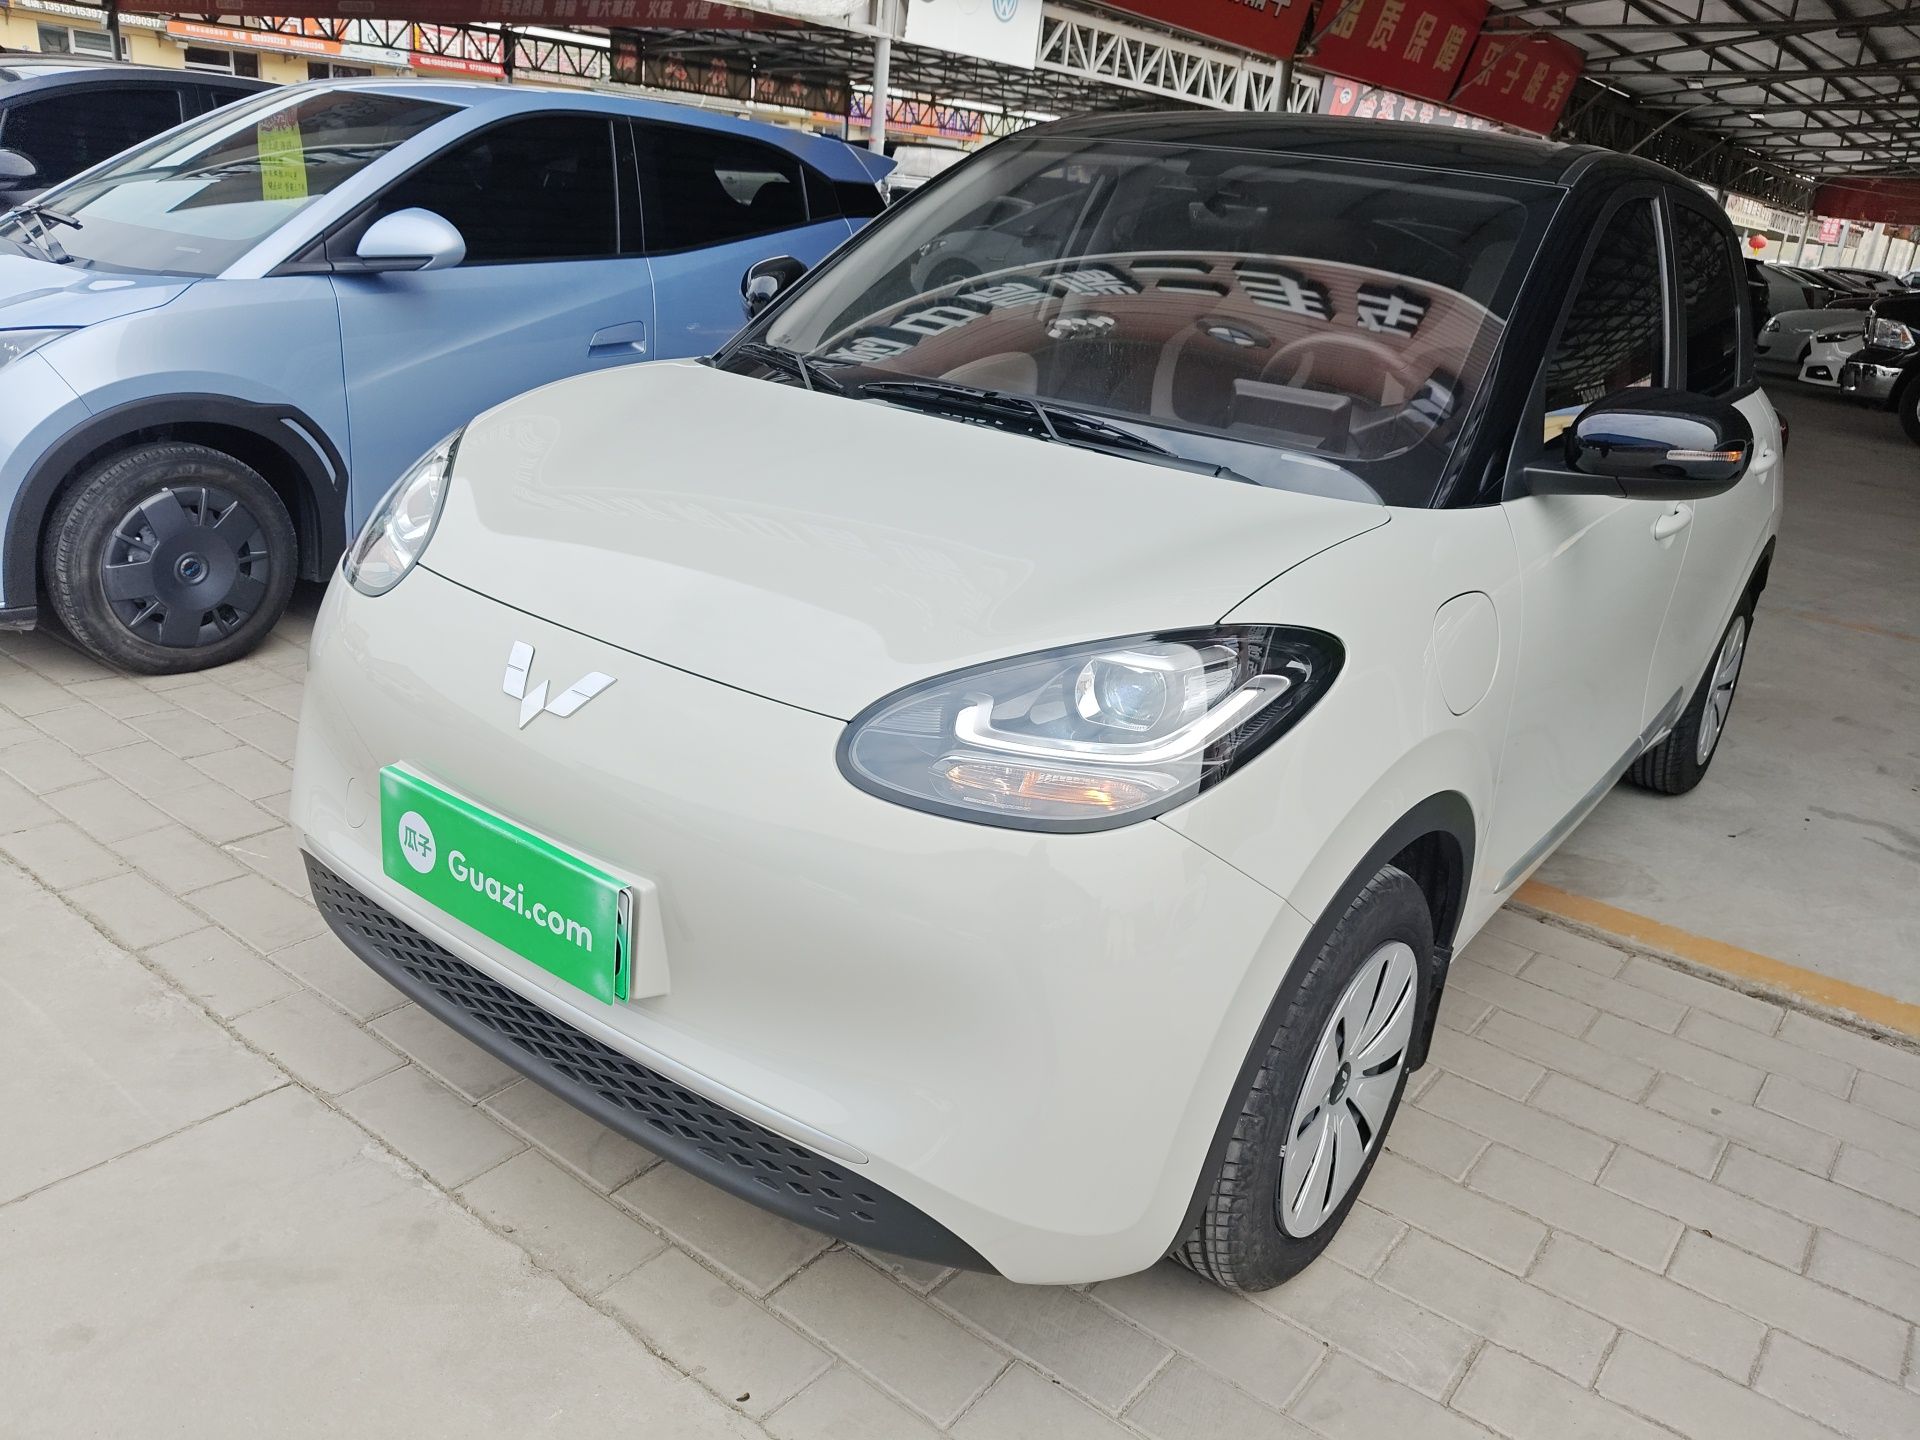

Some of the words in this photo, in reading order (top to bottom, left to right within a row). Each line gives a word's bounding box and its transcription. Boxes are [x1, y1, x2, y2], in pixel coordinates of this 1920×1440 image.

[1330, 0, 1467, 72] 品质保障
[403, 825, 432, 858] 瓜子
[448, 850, 593, 952] Guazi.com
